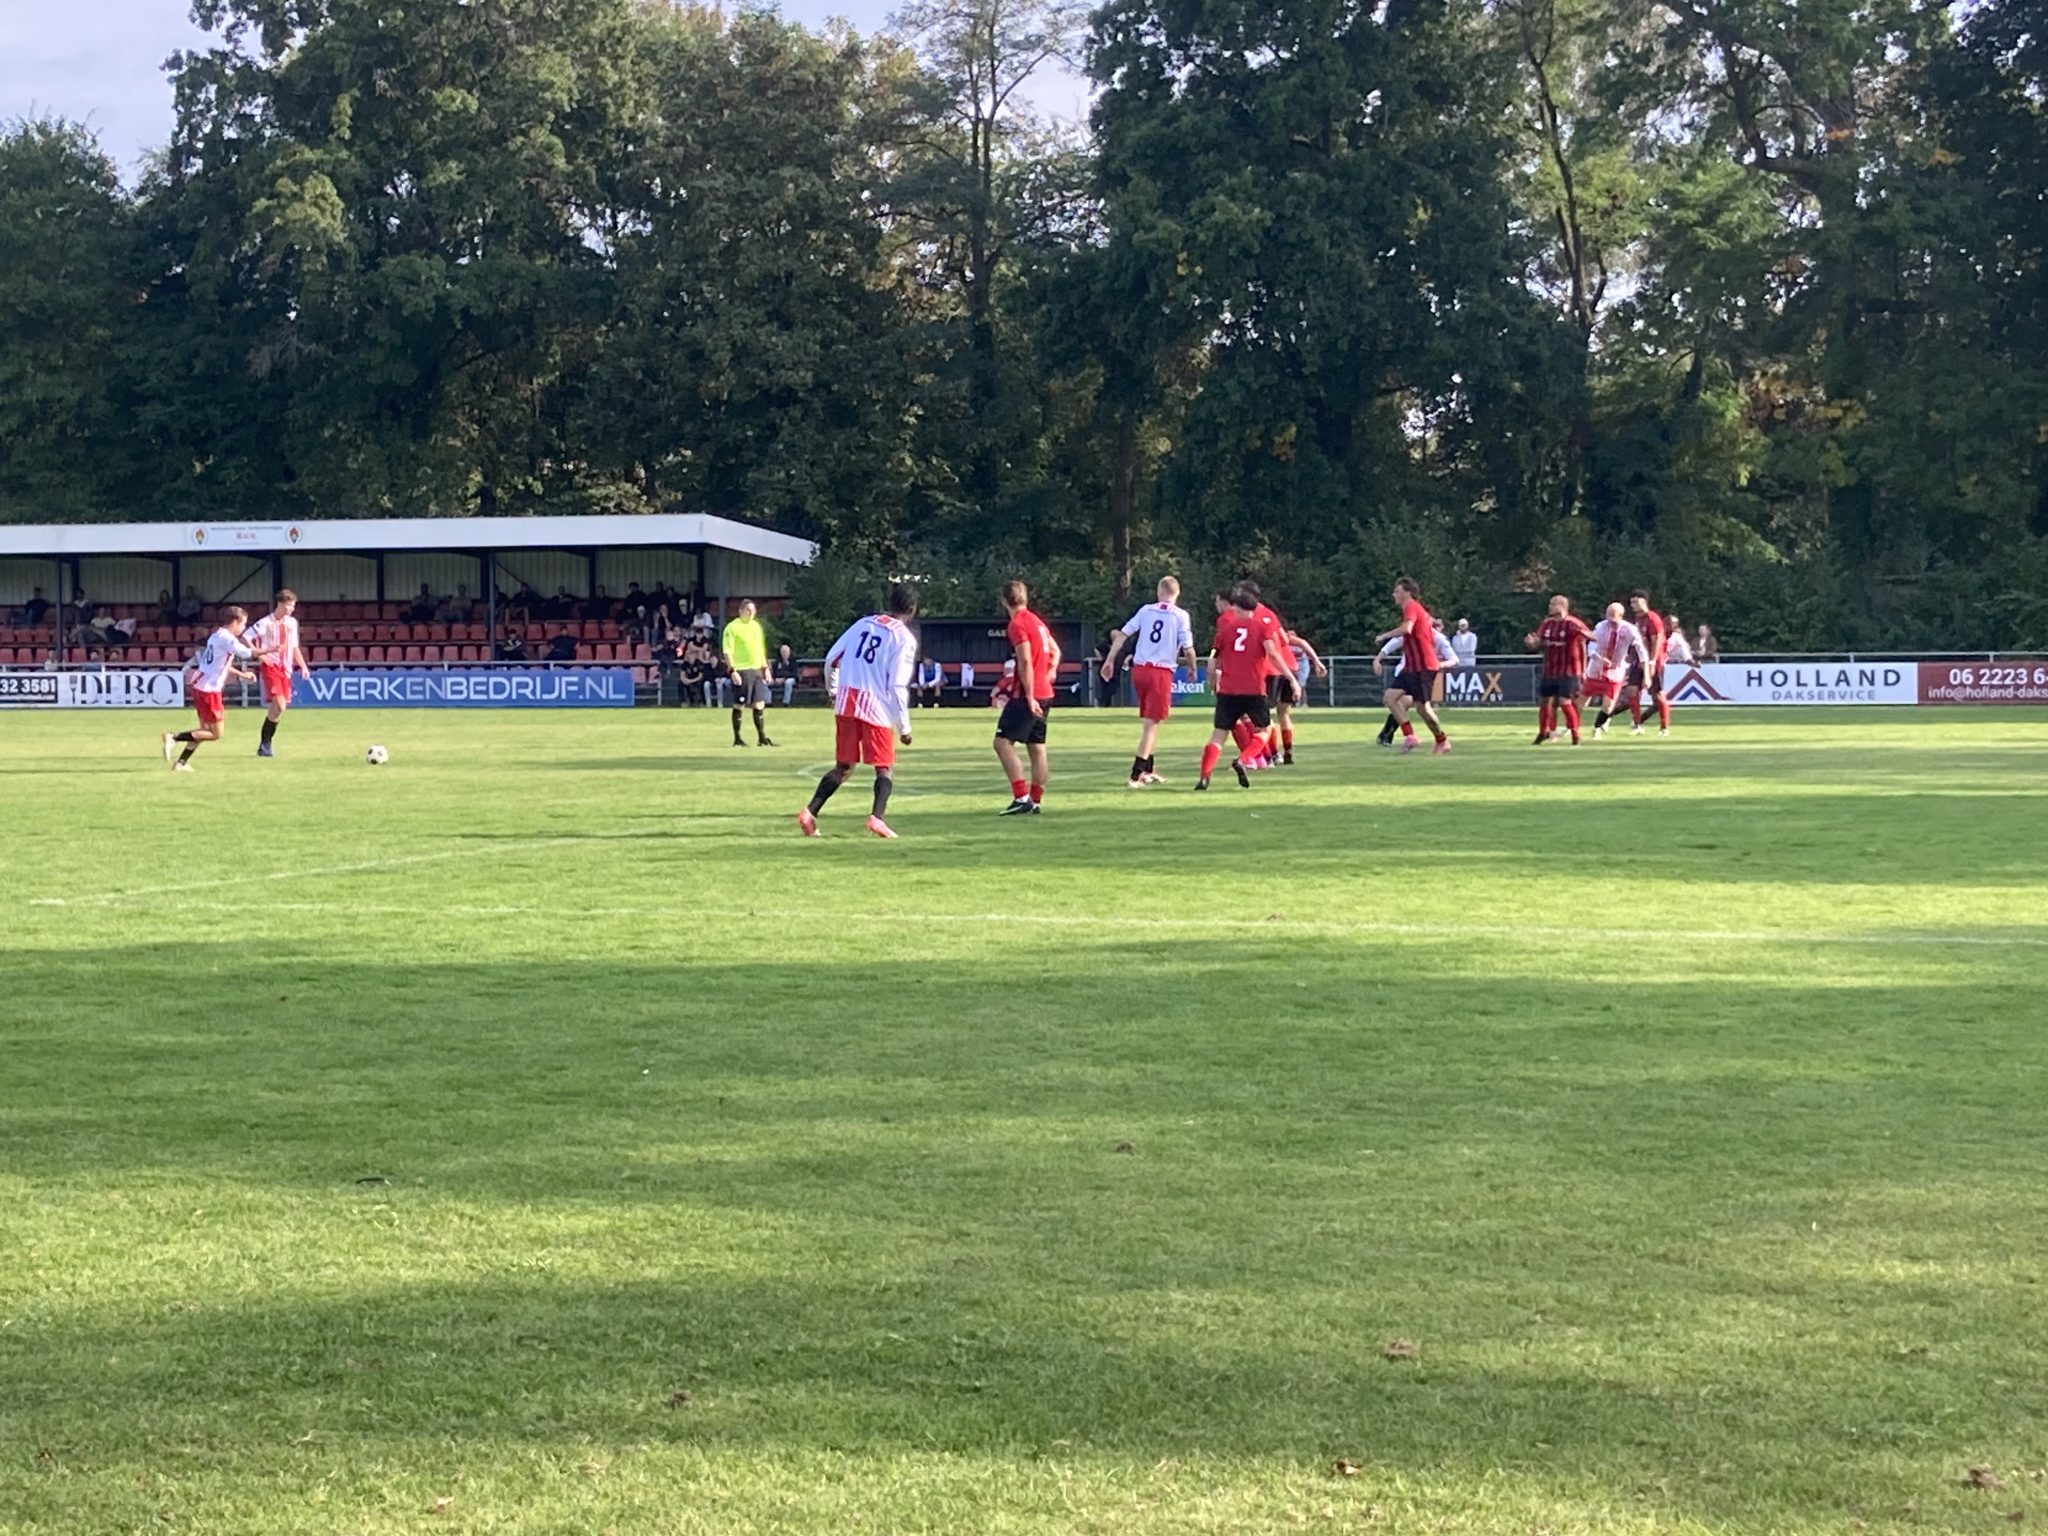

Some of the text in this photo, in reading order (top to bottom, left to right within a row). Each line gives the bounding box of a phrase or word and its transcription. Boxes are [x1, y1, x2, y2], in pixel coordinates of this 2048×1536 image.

[1150, 619, 1164, 643] 8
[1234, 627, 1248, 652] 2
[855, 631, 882, 664] 18
[0, 679, 56, 693] 32 3581
[1171, 680, 1206, 694] eken
[1445, 672, 1503, 701] MAX
[1746, 669, 1901, 687] HOLLAND
[1949, 668, 2048, 685] 06 2223 6
[308, 676, 627, 701] WERKENBEDRIJF.NL
[1771, 690, 1876, 701] DAKSERVICE
